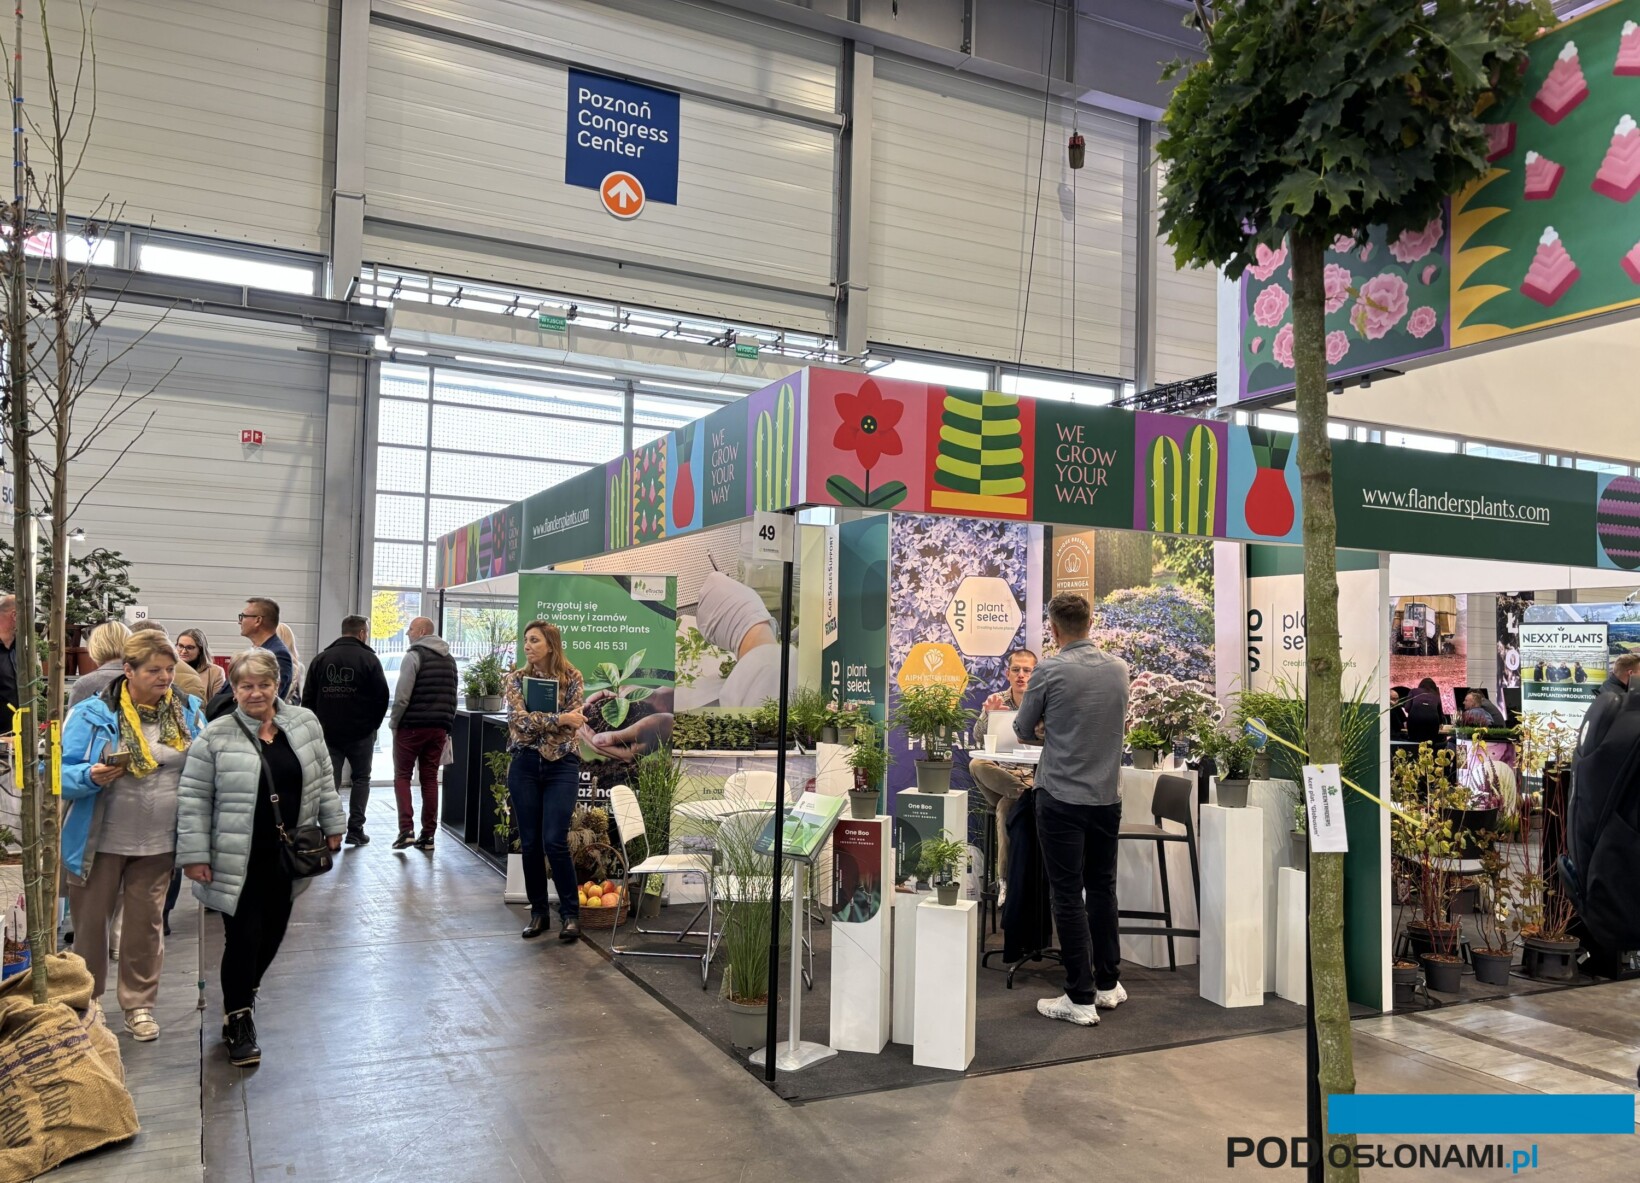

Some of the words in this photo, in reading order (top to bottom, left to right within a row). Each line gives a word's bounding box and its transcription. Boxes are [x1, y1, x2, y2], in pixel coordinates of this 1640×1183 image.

[578, 87, 651, 119] Poznań
[578, 109, 669, 143] Congress
[577, 130, 645, 158] Center
[712, 428, 725, 448] WE
[1056, 423, 1085, 444] WE
[711, 442, 739, 467] GROW
[1056, 443, 1117, 467] GROW
[711, 464, 735, 486] YOUR
[1055, 463, 1108, 487] YOUR
[2, 486, 14, 505] 50
[710, 484, 730, 506] WAY
[1055, 484, 1099, 505] WAY
[1362, 488, 1550, 524] www.flandersplants.com
[533, 508, 590, 539] www.flandersplants.com
[759, 525, 775, 540] 49
[1056, 539, 1070, 557] UNIQUE
[1057, 581, 1088, 589] HYDRANGEA
[537, 601, 582, 611] Przygotuj
[583, 602, 598, 611] się
[977, 602, 1004, 613] plant
[536, 612, 549, 621] do
[552, 612, 585, 623] wiosny
[587, 613, 590, 621] i
[592, 613, 627, 622] zamów
[977, 613, 1008, 622] select
[581, 624, 618, 633] eTracto
[620, 625, 650, 633] Plants
[1522, 633, 1559, 643] NEXXT
[1561, 633, 1603, 643] PLANTS
[572, 641, 591, 650] 506
[593, 642, 610, 650] 415
[612, 642, 627, 650] 531
[846, 663, 868, 679] plant
[846, 678, 871, 693] select
[1321, 785, 1331, 827] GREENTRADERS
